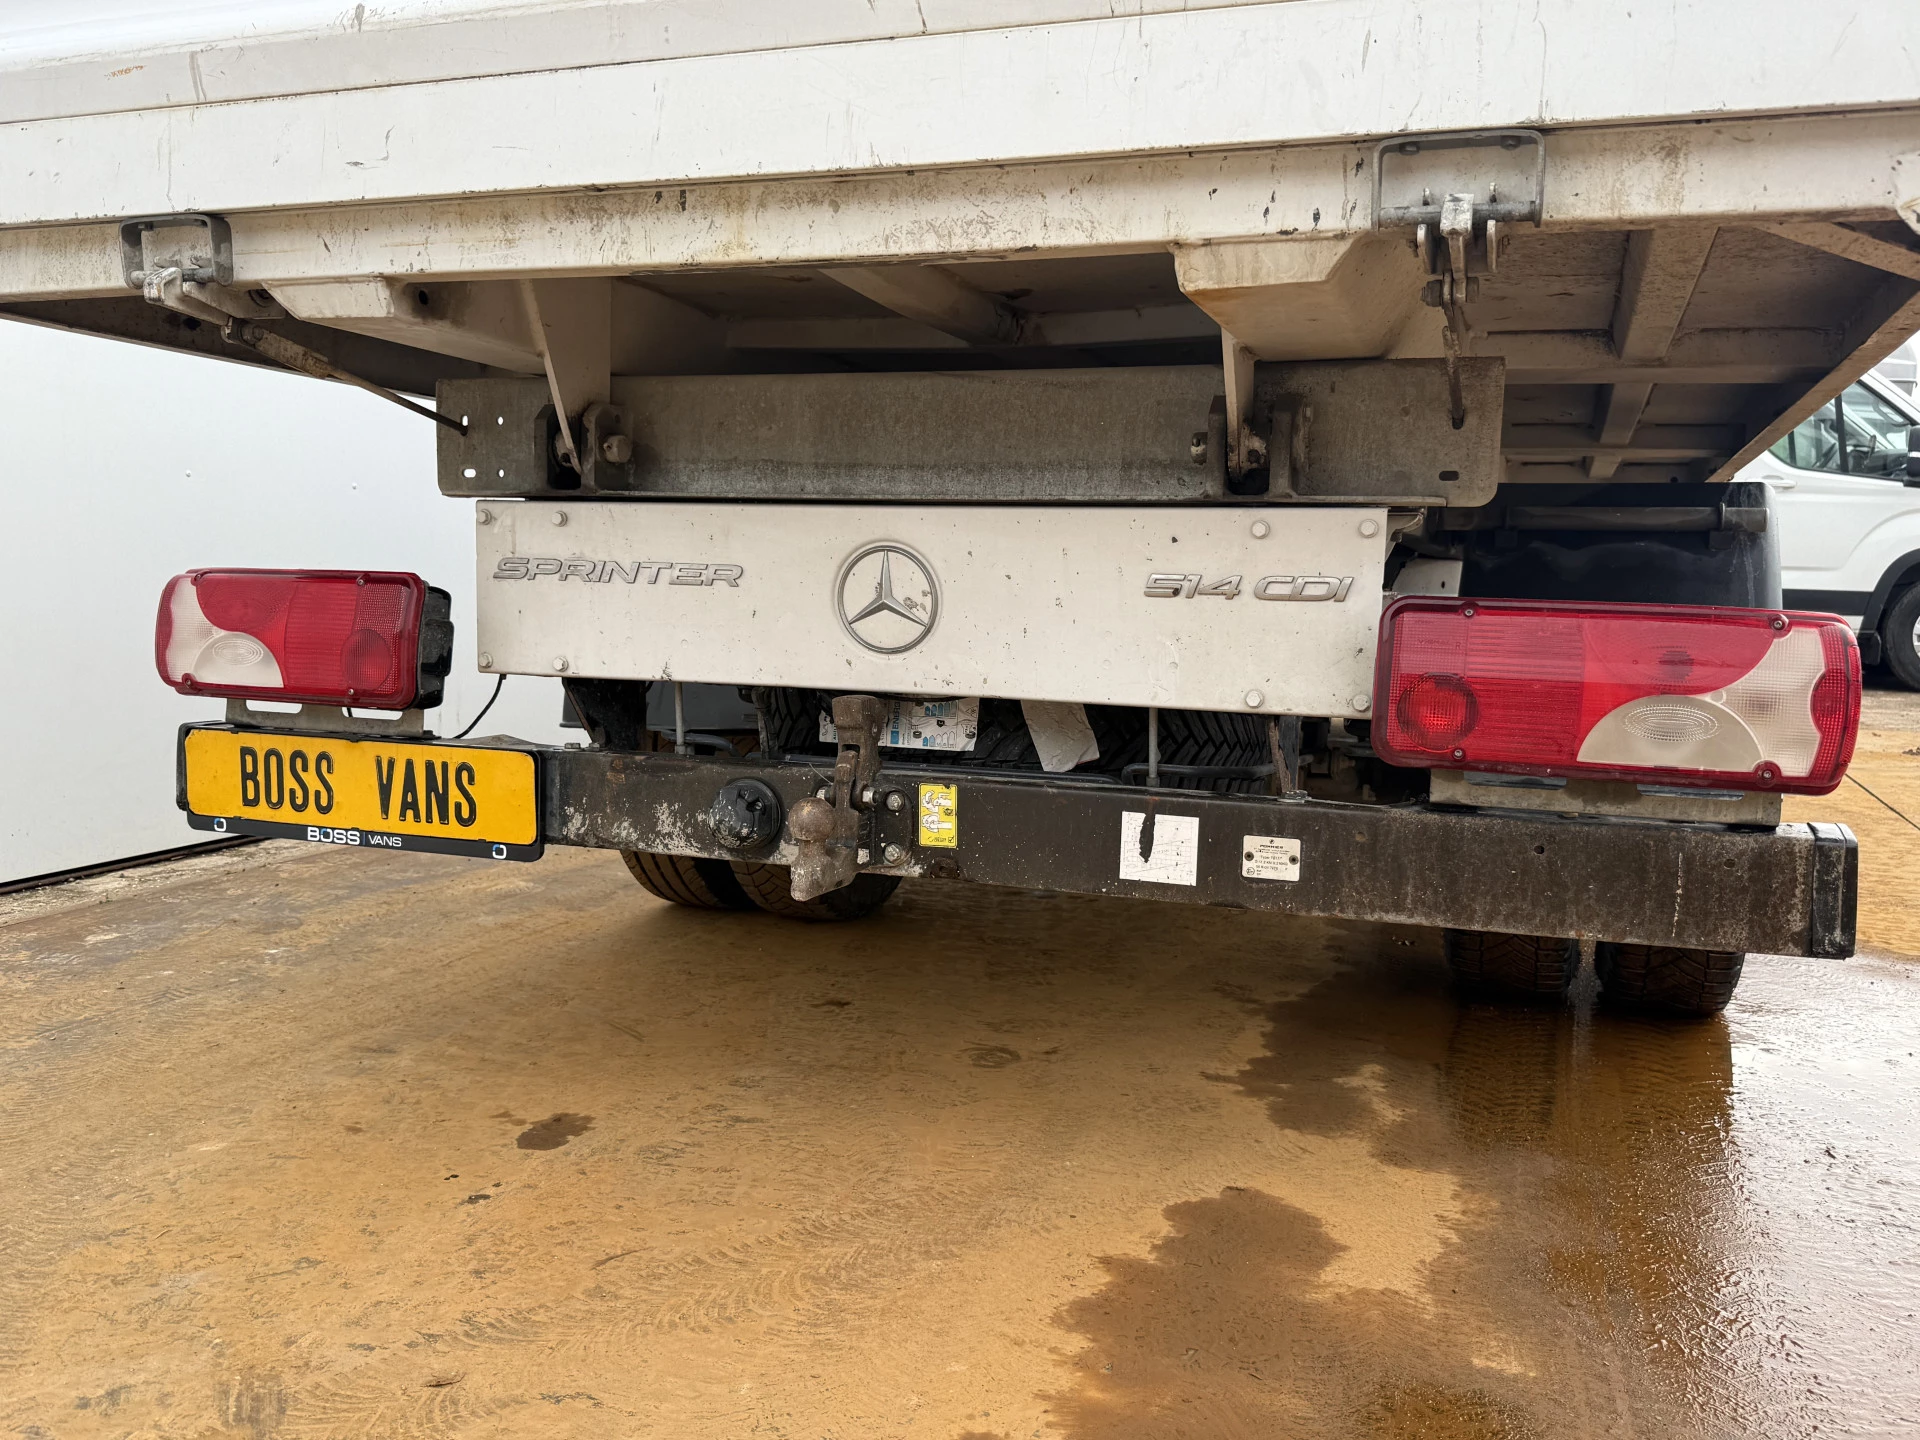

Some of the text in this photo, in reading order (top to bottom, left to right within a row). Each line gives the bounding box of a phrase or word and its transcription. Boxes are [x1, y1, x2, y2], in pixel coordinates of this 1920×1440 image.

[493, 557, 744, 587] SPRINTER
[1144, 573, 1355, 602] 514 CDI
[240, 746, 476, 827] BOSS VANS
[307, 827, 402, 847] BOSS VANS
